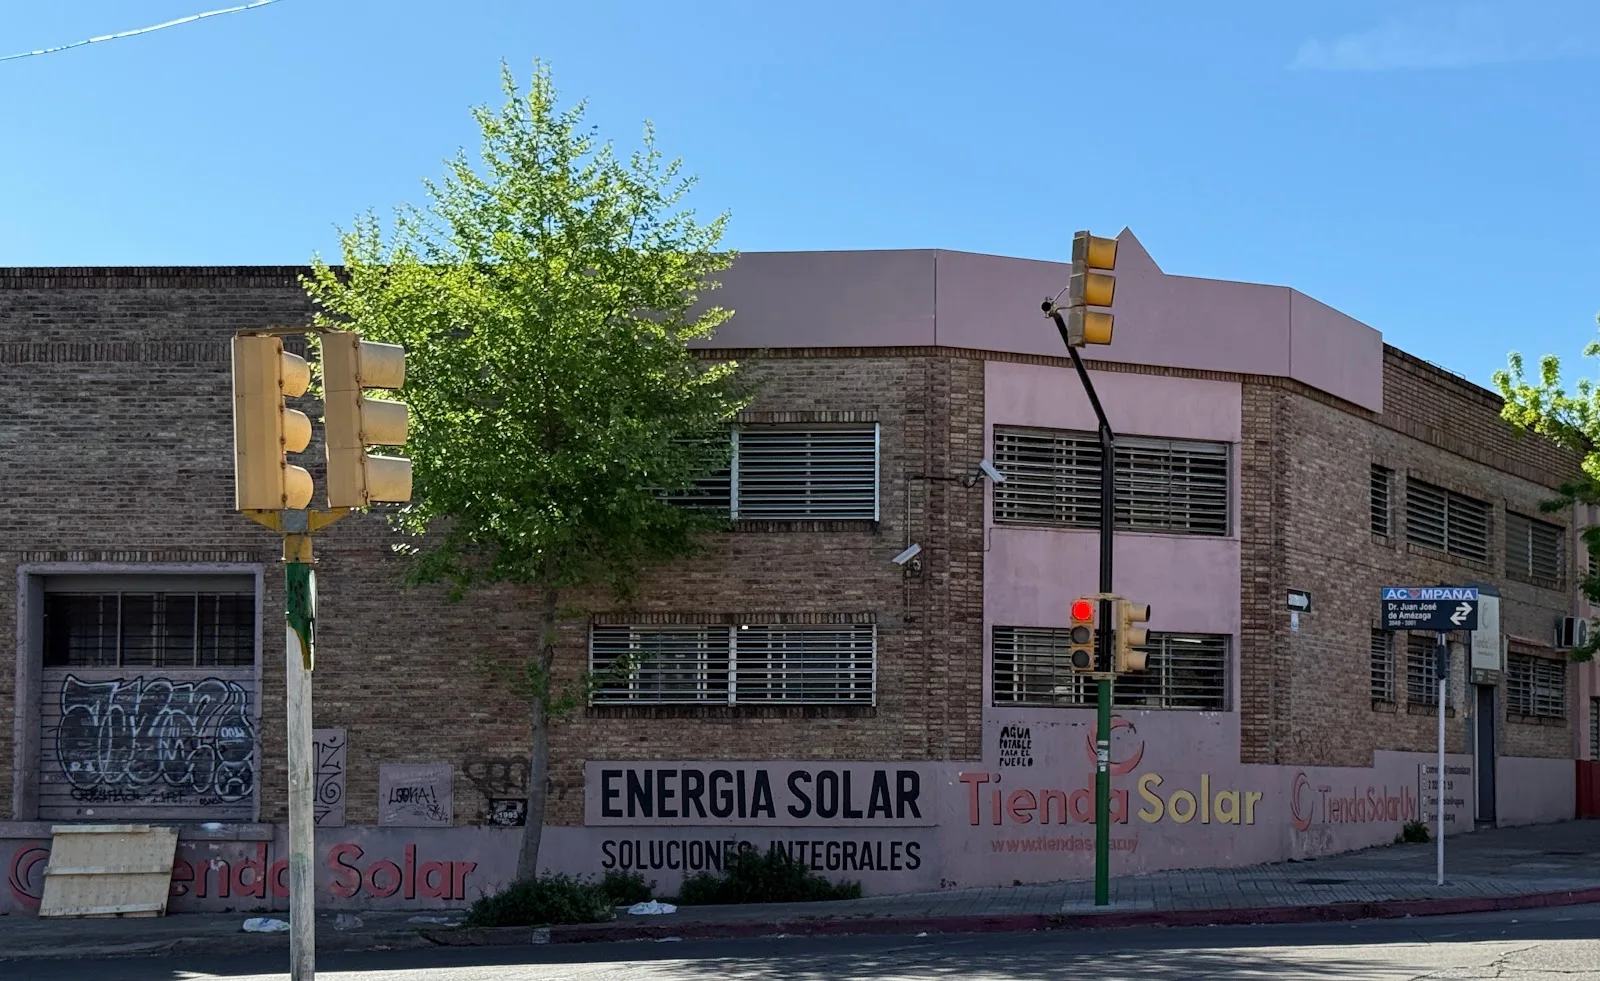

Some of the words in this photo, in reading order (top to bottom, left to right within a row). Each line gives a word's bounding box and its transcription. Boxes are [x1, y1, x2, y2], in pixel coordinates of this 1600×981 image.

[1388, 603, 1399, 611] Dr.
[1400, 603, 1418, 611] Juan
[1419, 602, 1437, 611] José
[1388, 611, 1398, 620] de
[1398, 611, 1432, 622] Amézaga
[1000, 726, 1031, 739] AGUA
[999, 738, 1032, 749] POTABLE
[1021, 749, 1031, 757] EL
[999, 757, 1033, 767] PUEBLO
[602, 769, 776, 819] ENERGIA
[787, 769, 922, 819] SOLAR
[959, 772, 1129, 826] Tienda
[1137, 772, 1263, 825] Solar
[991, 835, 1138, 854] www.tiendasar.uy
[770, 839, 922, 871] INTEGRALES
[170, 841, 290, 899] enda
[328, 843, 478, 900] Solar
